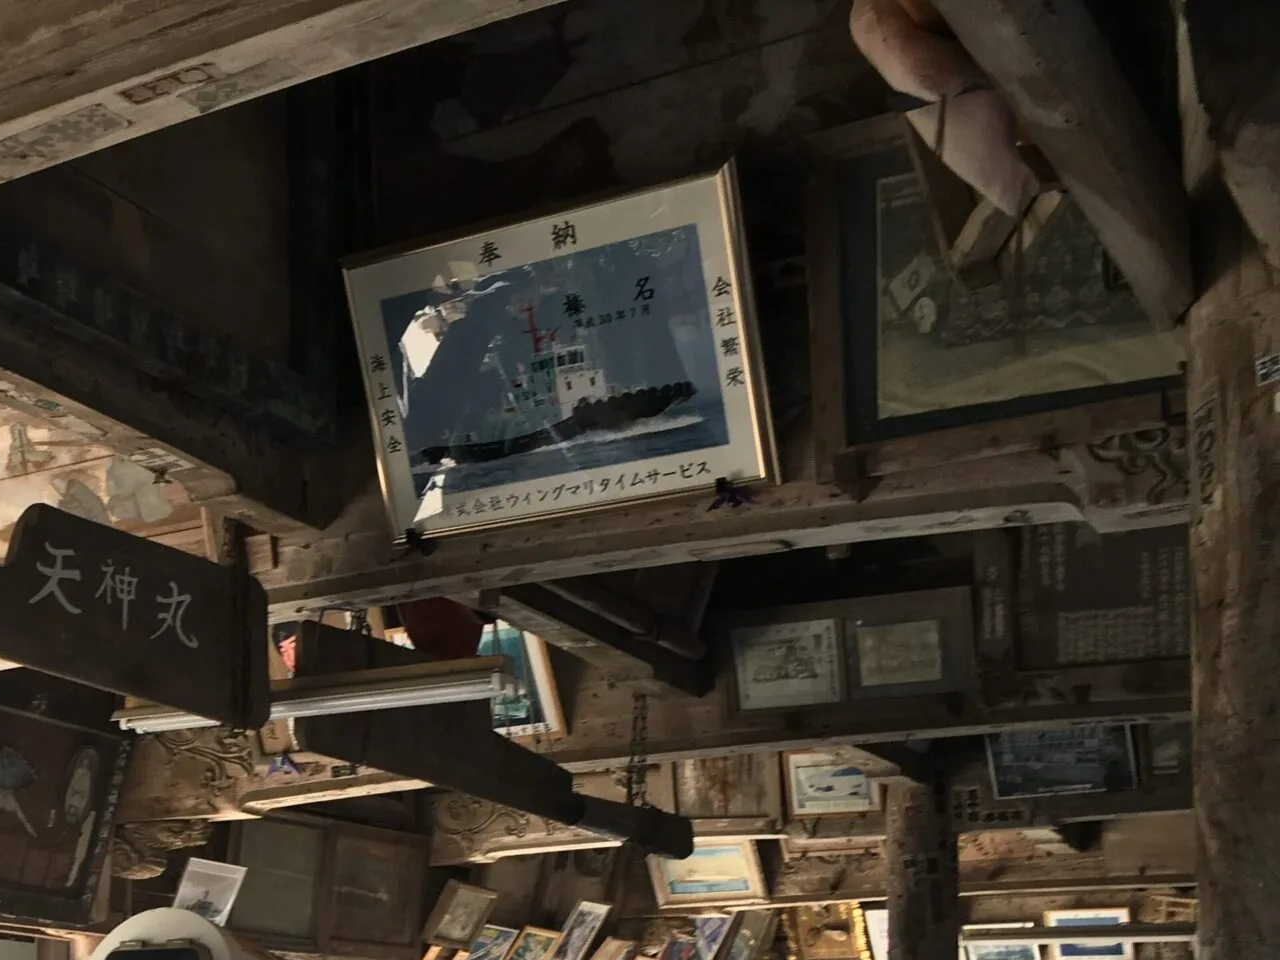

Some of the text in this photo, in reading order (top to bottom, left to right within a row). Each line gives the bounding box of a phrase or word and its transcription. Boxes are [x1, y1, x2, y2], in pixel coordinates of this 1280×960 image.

[477, 222, 579, 267] 奉納
[710, 274, 746, 388] 会社繁栄
[368, 352, 404, 456] 海上安全
[28, 541, 199, 649] 天神丸
